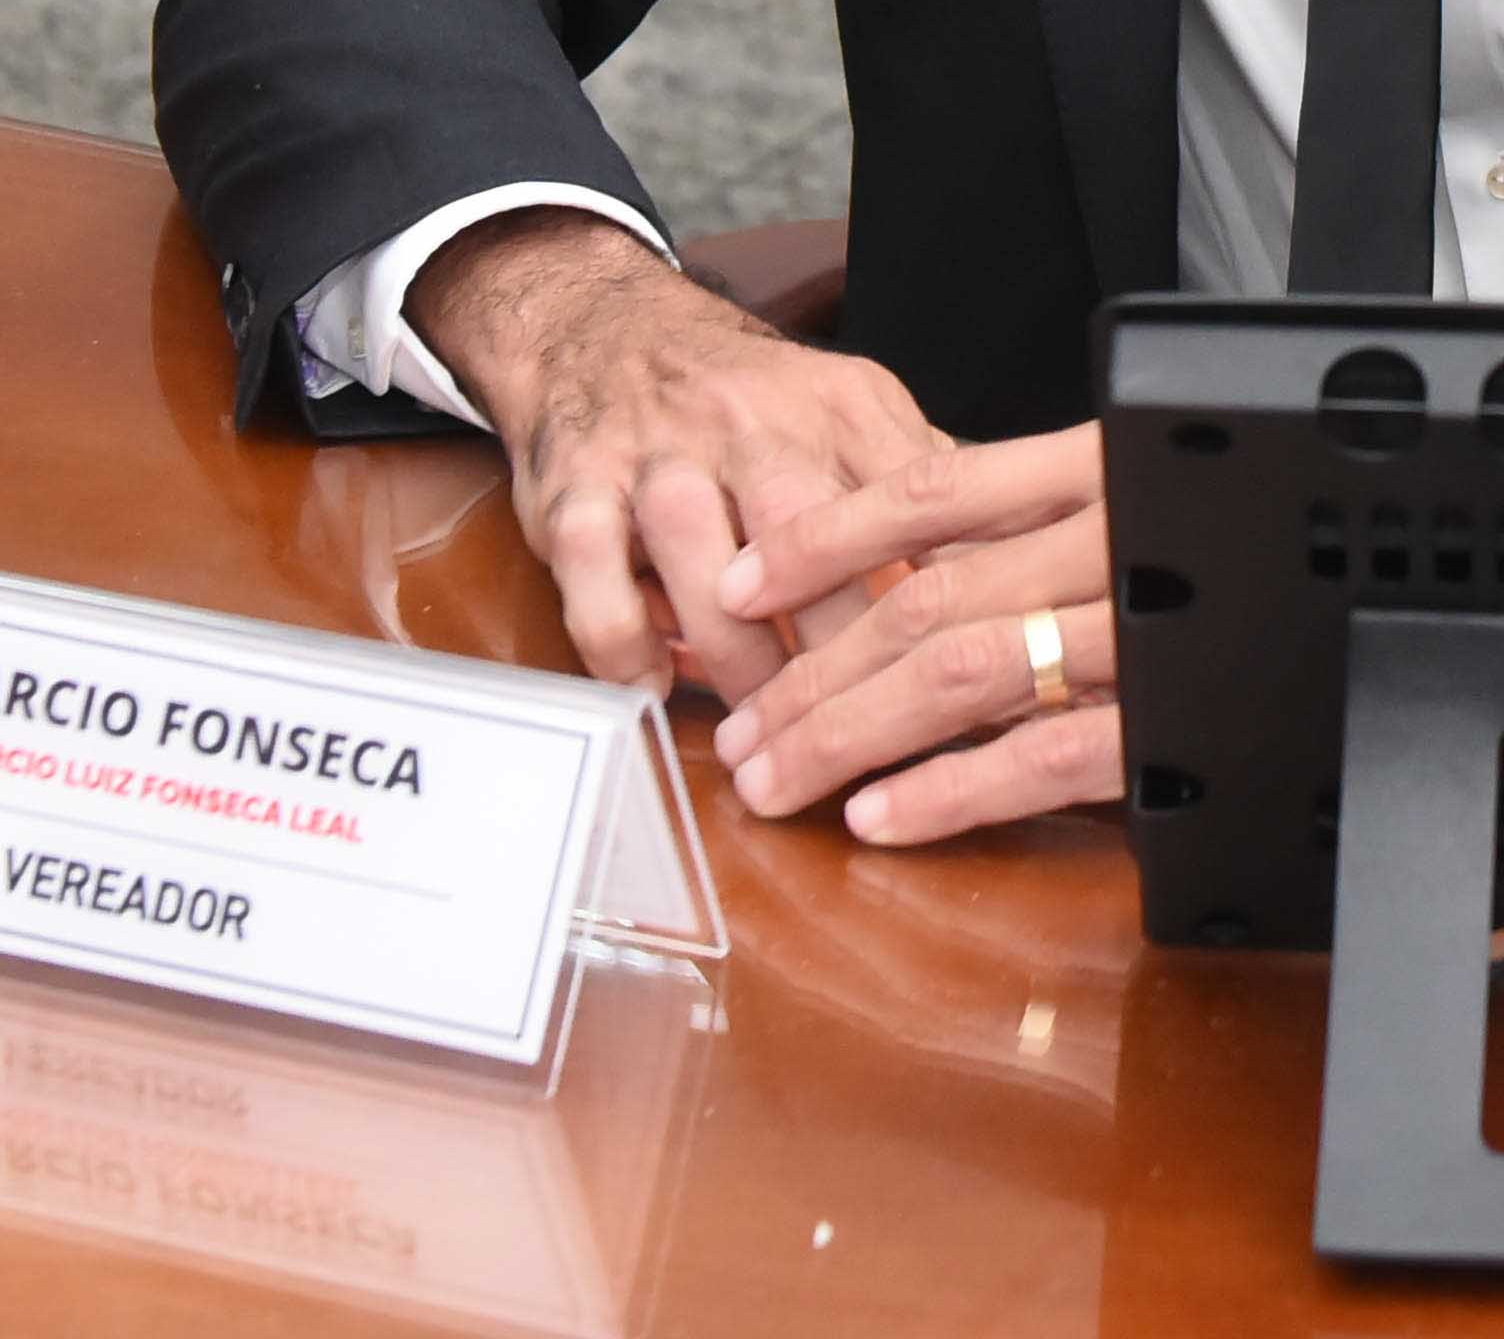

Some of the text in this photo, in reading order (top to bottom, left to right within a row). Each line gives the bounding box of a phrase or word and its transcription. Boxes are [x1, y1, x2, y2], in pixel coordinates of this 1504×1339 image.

[156, 699, 422, 796] FONSECA
[64, 760, 134, 796] LUIZ
[139, 773, 282, 828] FONSECA
[289, 804, 364, 843] LEAL
[4, 846, 251, 939] VEREADOR
